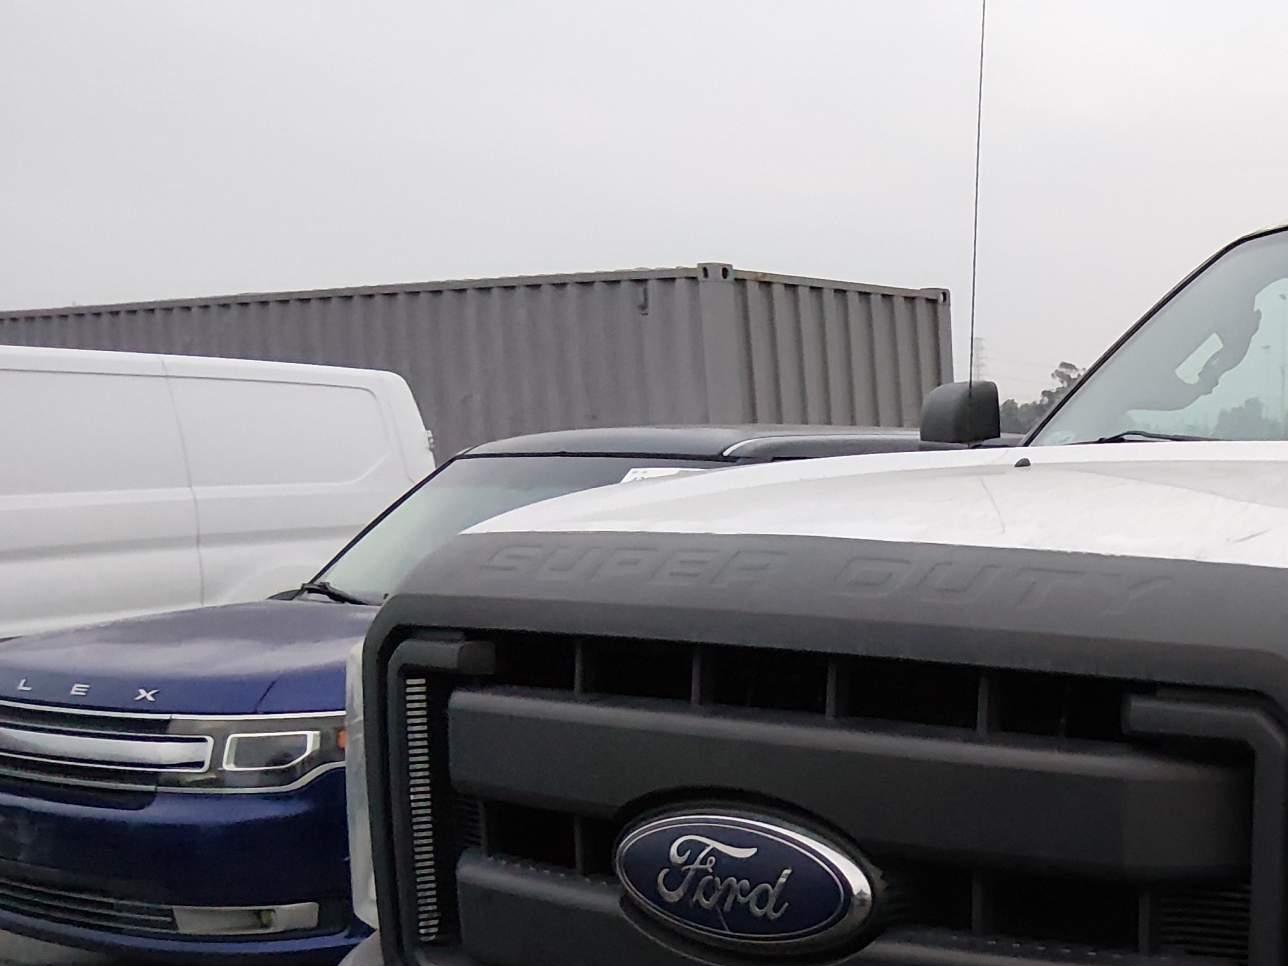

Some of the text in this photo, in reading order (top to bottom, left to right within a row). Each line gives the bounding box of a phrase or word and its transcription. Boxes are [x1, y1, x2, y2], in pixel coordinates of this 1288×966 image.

[479, 541, 1176, 614] SUPER DUTY
[656, 834, 793, 921] Ford
